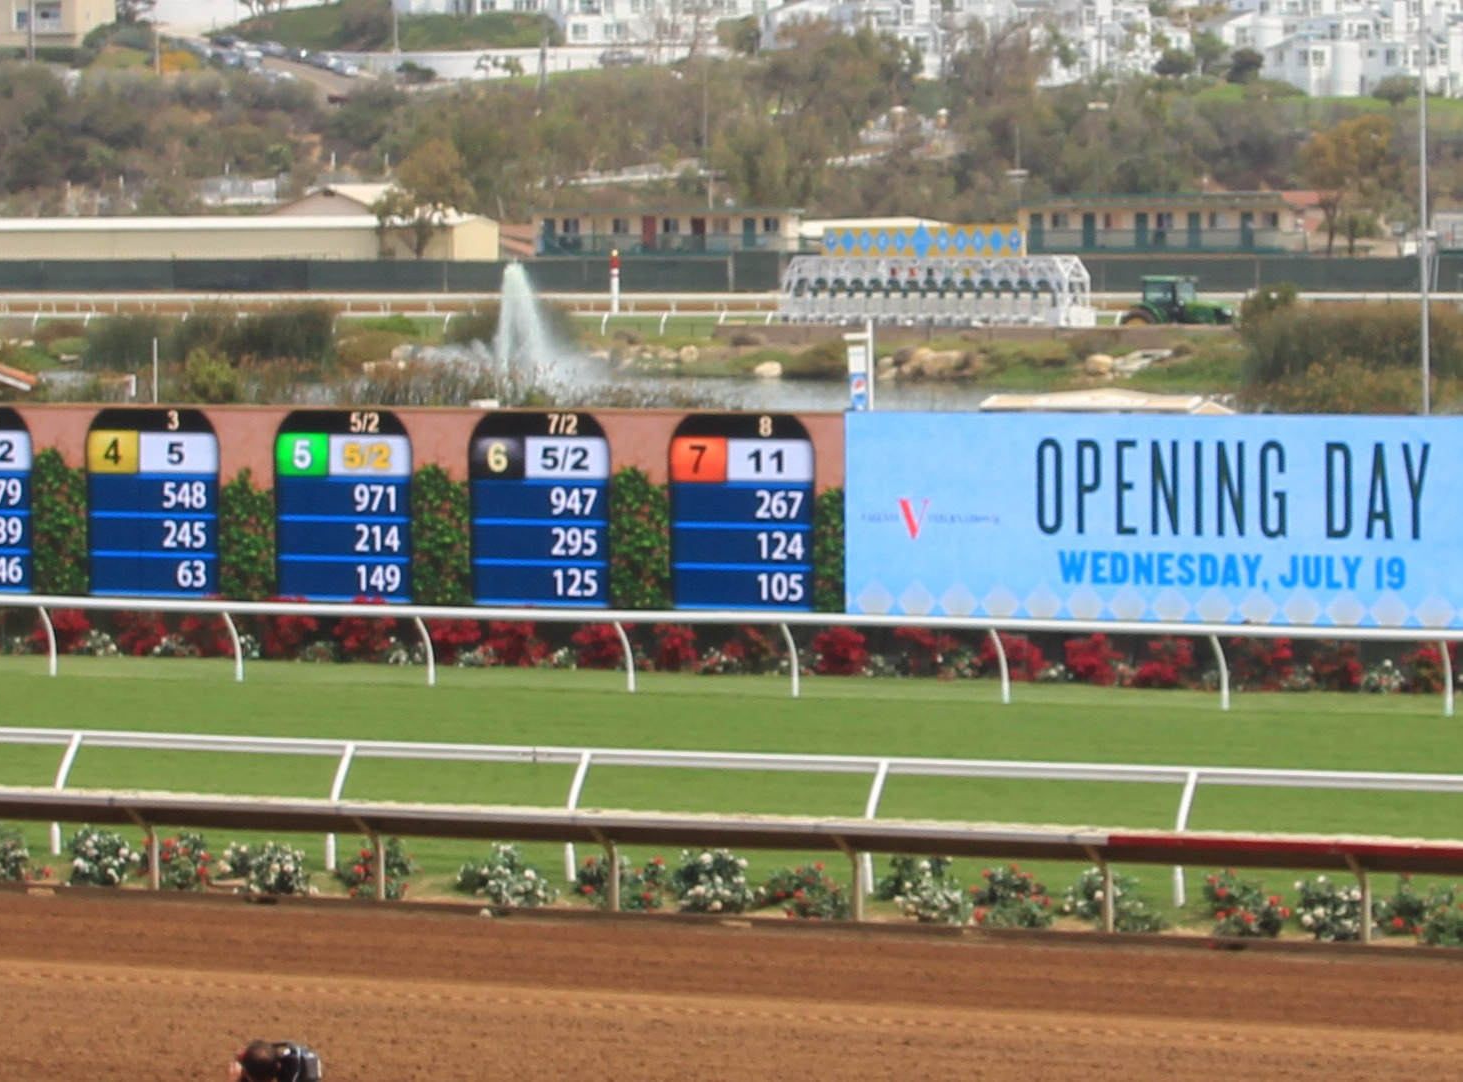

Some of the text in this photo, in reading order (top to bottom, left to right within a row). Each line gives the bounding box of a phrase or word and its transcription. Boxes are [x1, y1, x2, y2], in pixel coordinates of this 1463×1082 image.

[167, 411, 180, 431] 3
[349, 412, 379, 433] 5/2
[547, 414, 578, 435] 7/2
[759, 415, 773, 436] 8
[103, 438, 184, 464] 4 5
[293, 440, 392, 470] 5 5/2
[487, 444, 590, 473] 6 5/2
[689, 446, 785, 474] 7 11
[162, 481, 206, 509] 548
[354, 484, 397, 512] 971
[549, 487, 597, 516] 947
[1037, 437, 1431, 540] OPENING DAY
[755, 490, 803, 519] 267
[162, 520, 206, 548] 245
[354, 524, 401, 552] 214
[551, 528, 597, 556] 295
[757, 531, 804, 559] 124
[177, 560, 206, 588] 63
[356, 563, 402, 592] 149
[553, 569, 598, 597] 125
[1057, 550, 1407, 591] WEDNESDAY, JULY 19
[757, 573, 804, 601] 105
